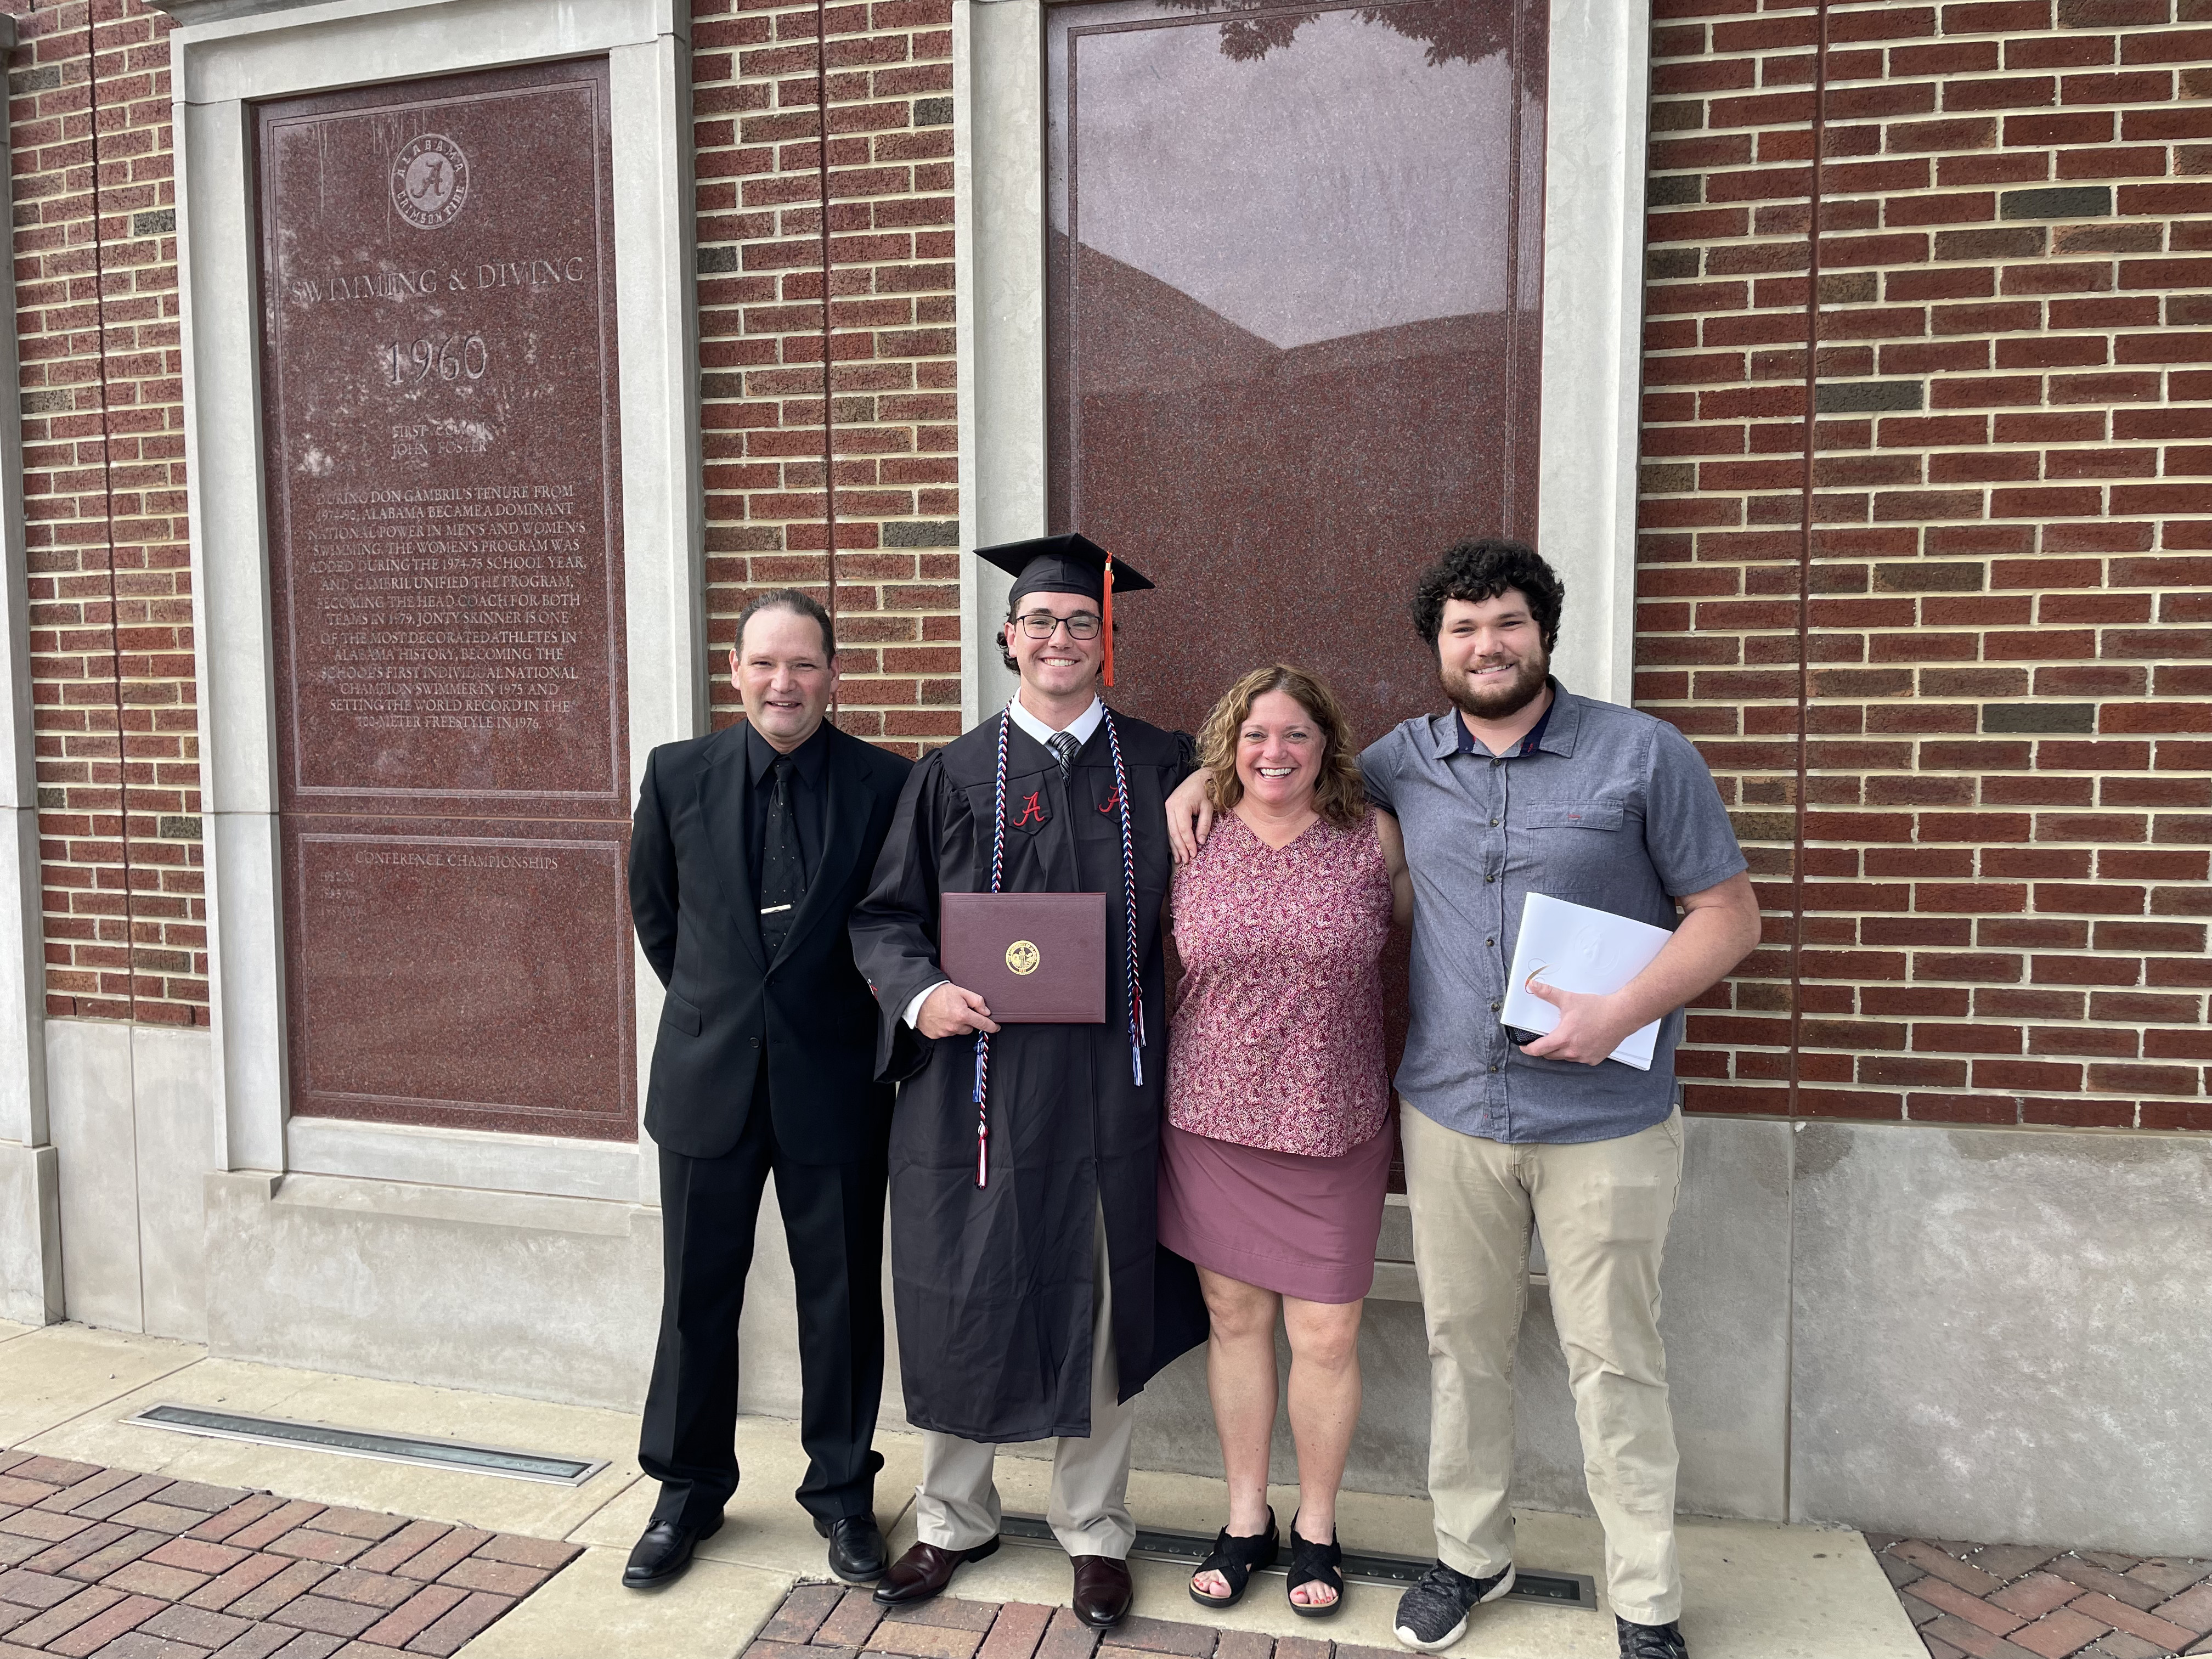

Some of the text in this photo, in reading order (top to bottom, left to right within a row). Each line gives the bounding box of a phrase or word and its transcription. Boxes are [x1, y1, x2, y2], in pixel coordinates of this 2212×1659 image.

[396, 139, 464, 179] ALABAMA
[410, 161, 445, 199] A
[397, 185, 465, 224] CRIMSON TIDE
[290, 256, 583, 303] SWIMMING & DIVING
[388, 335, 487, 383] 1960
[392, 421, 486, 438] FIRST COACH
[391, 441, 487, 460] JOHN FOSTER
[317, 485, 574, 505] DURING DON GAMBRIL'S TENURE FROM
[362, 505, 425, 520] ALABAMA
[427, 504, 481, 518] BECAME
[484, 505, 493, 516] A
[495, 502, 574, 516] DOMINANT
[308, 521, 586, 540] NATIONAL POWER IN MEN'S AND WOMEN'S
[388, 541, 414, 555] THE
[416, 540, 478, 554] WOMEN'S
[481, 539, 548, 552] PROGRAM
[551, 538, 580, 551] WAS
[308, 560, 354, 574] ADDED
[358, 558, 410, 572] DURING
[412, 557, 439, 571] THE
[486, 556, 544, 569] SCHOOL
[547, 555, 586, 569] YEAR,
[320, 575, 574, 591] AND GAMBRIL UNIFIED THE PROGRAM,
[316, 593, 581, 610] BECOMING THE HEAD COACH FOR BOTH
[326, 613, 368, 625] TEAMS
[371, 612, 385, 625] IN
[417, 611, 462, 628] JONTY
[463, 611, 522, 624] SKINNER
[525, 611, 537, 624] IS
[539, 611, 569, 624] ONE
[321, 630, 577, 645] OF THE MOST DECORATED ATHLETES IN
[335, 647, 564, 662] ALABAMA HISTORY, BECOMING THE
[386, 666, 420, 679] FIRST
[422, 665, 504, 679] INDIVIDUAL
[505, 665, 579, 679] NATIONAL
[340, 682, 558, 696] CHAMPION SWIMMER IN 1975 AND
[330, 698, 571, 713] SETTING THE WORLD RECORD IN THE
[425, 715, 493, 729] FREESTYLE
[496, 716, 512, 729] IN
[1013, 791, 1045, 827] A
[356, 851, 558, 870] CONFERENCE CHAMPIONSHIPS
